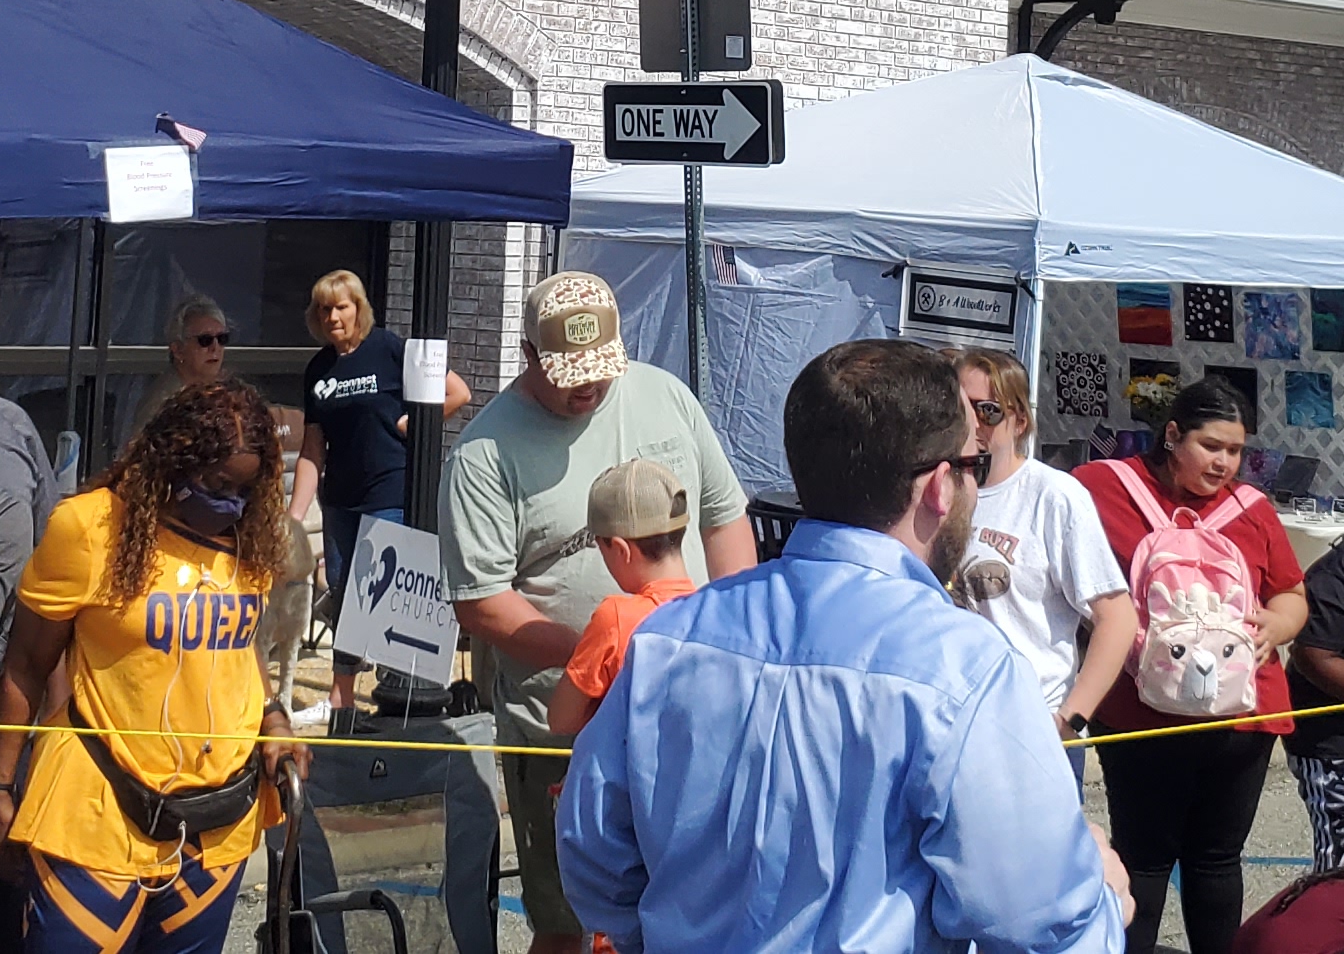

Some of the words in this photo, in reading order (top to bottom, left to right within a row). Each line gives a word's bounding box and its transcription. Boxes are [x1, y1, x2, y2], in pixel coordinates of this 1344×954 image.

[621, 107, 665, 137] ONE
[672, 108, 719, 139] WAY
[337, 374, 377, 389] connect
[978, 527, 1020, 566] BUZZ
[395, 566, 443, 602] conne
[389, 591, 457, 631] CHURCH
